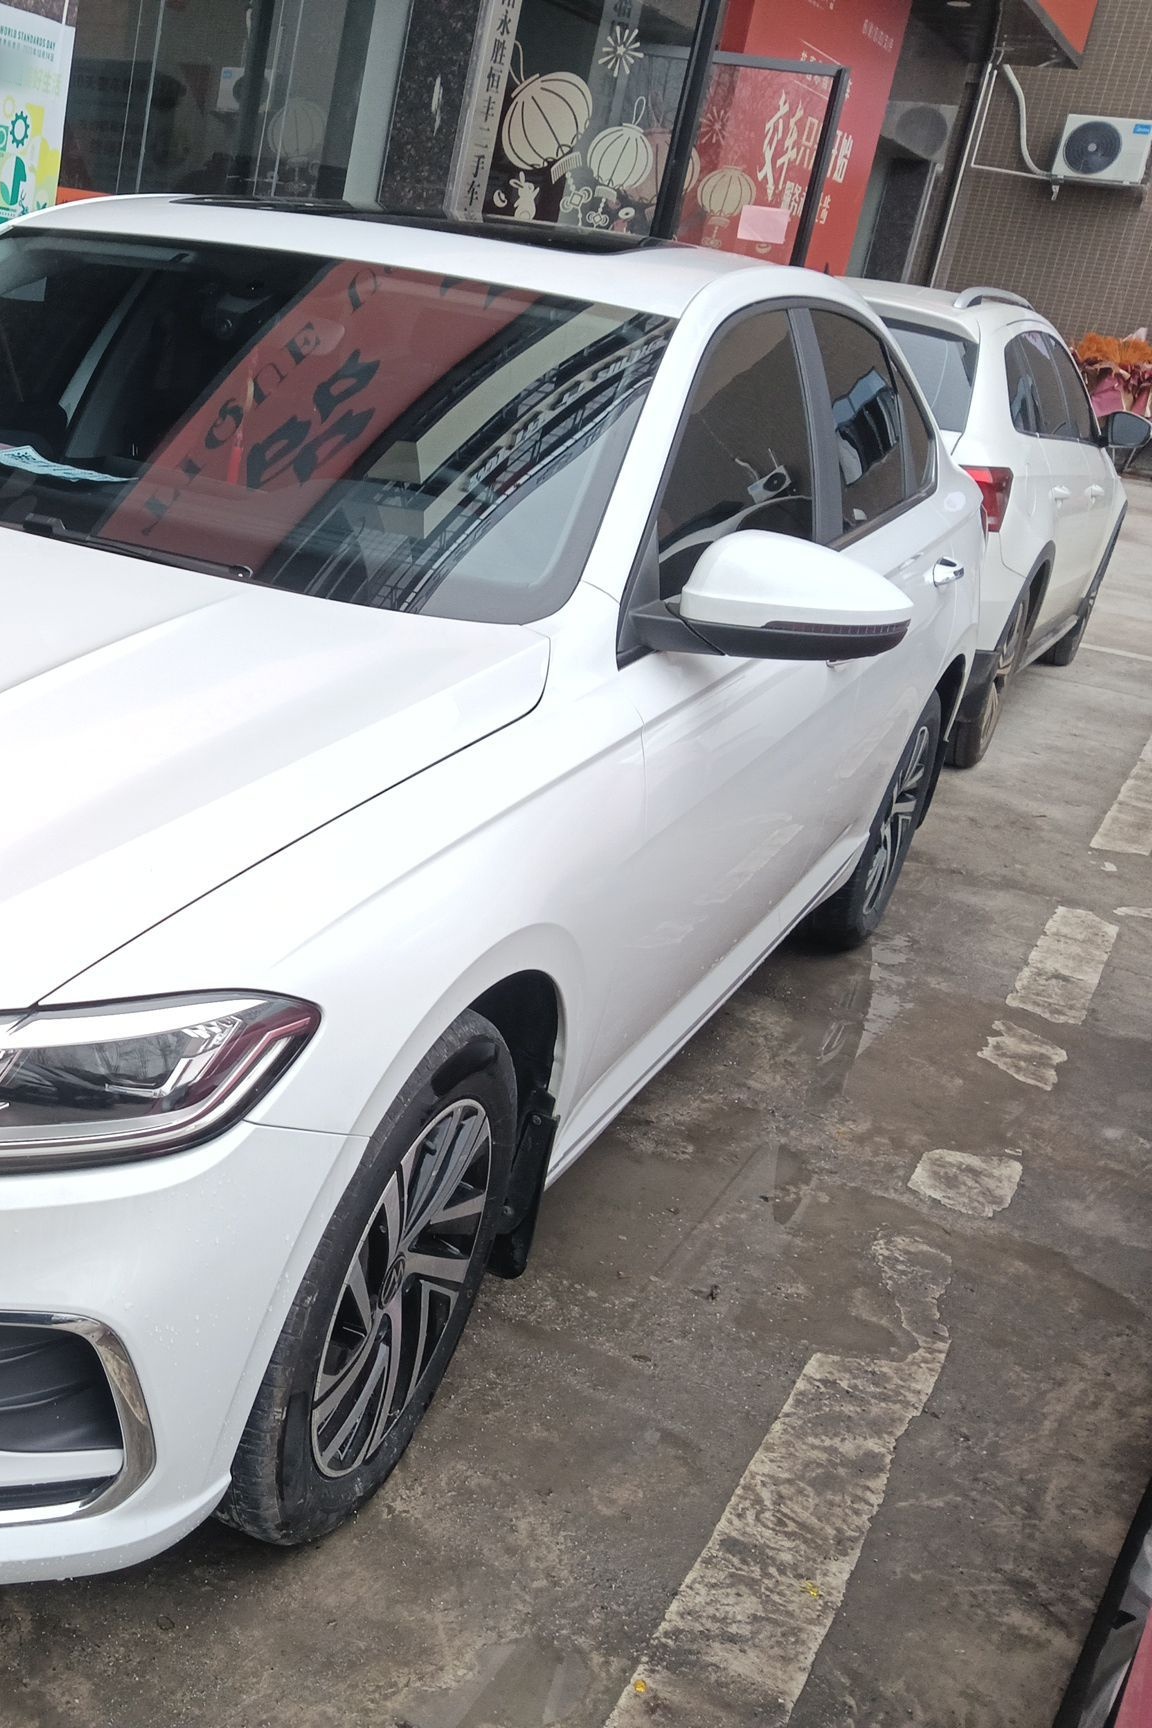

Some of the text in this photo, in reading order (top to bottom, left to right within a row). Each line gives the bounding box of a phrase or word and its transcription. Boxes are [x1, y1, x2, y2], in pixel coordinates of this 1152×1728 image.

[0, 25, 17, 38] WORLD
[17, 31, 46, 48] STANDARDS
[46, 40, 56, 51] DAY
